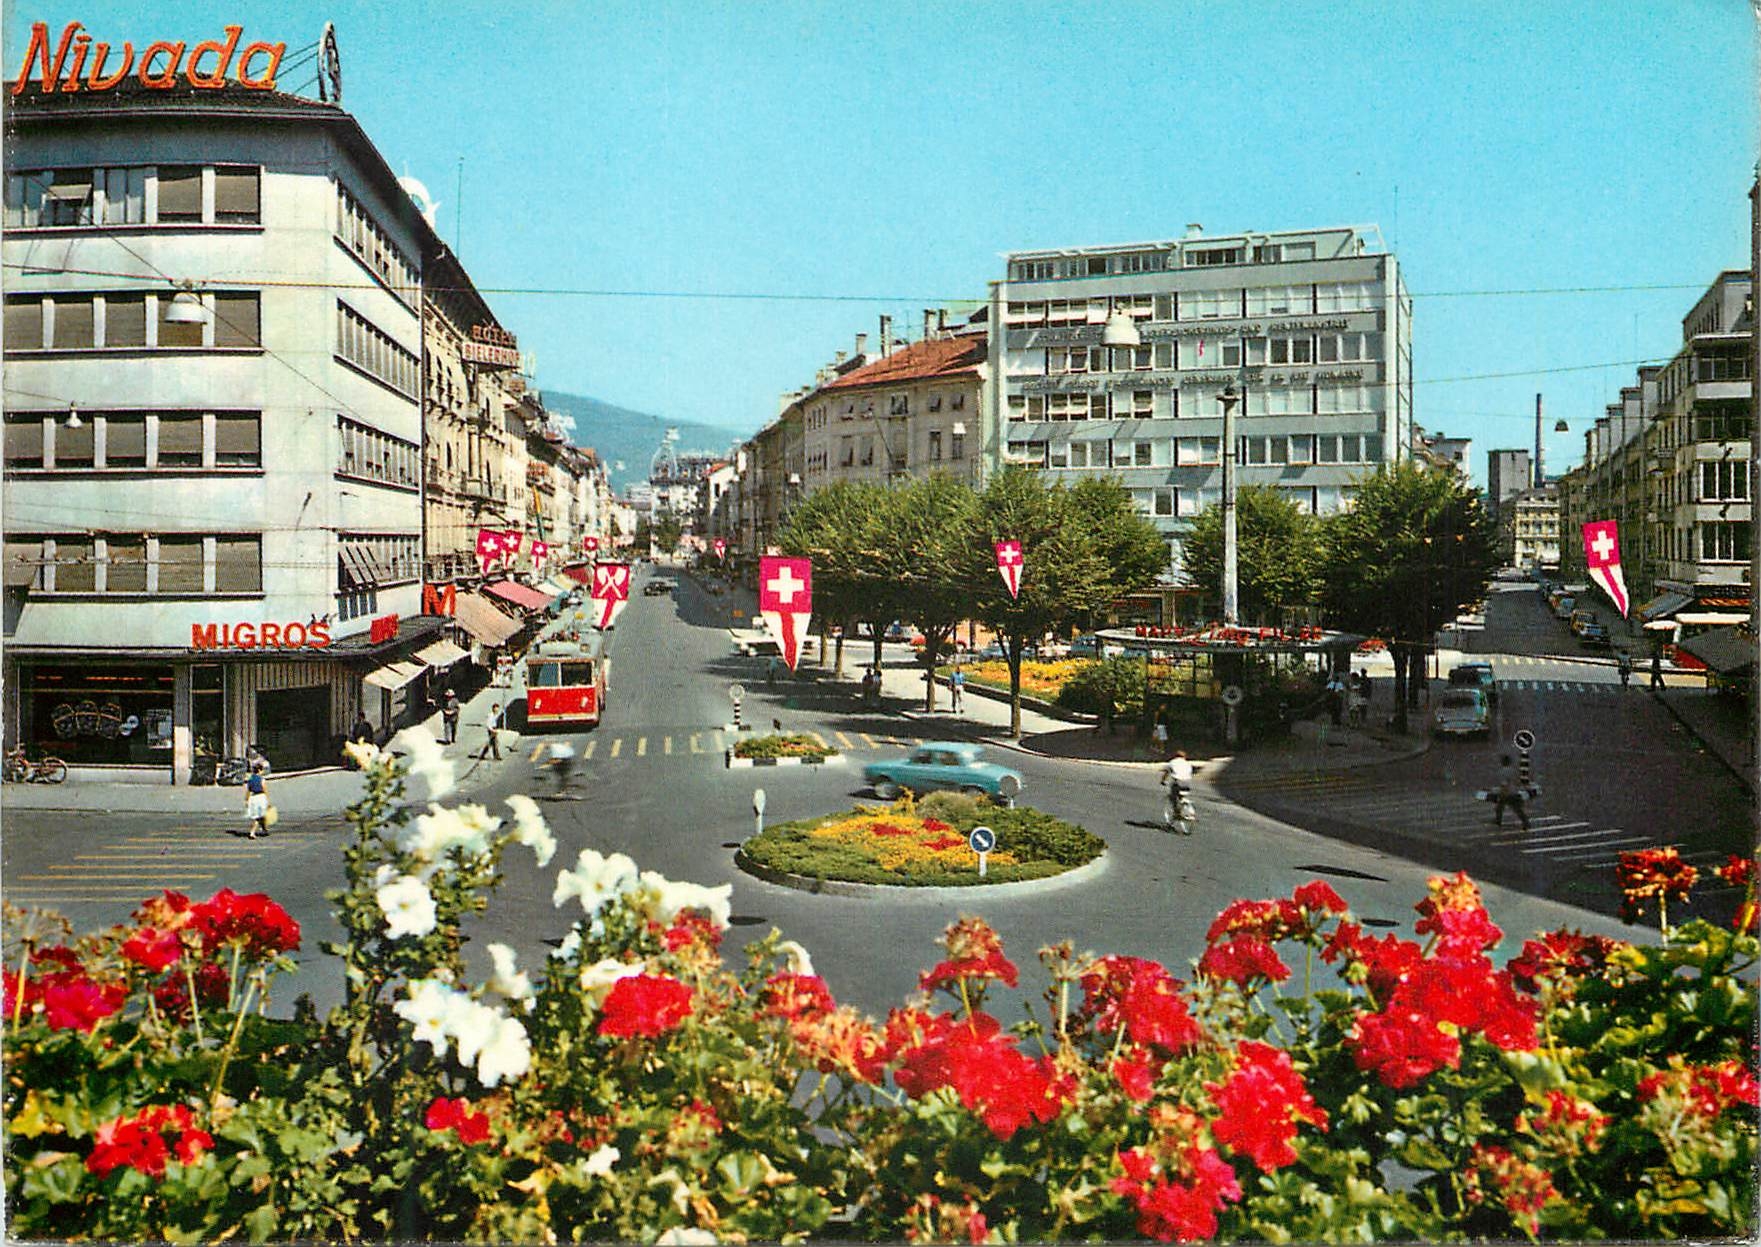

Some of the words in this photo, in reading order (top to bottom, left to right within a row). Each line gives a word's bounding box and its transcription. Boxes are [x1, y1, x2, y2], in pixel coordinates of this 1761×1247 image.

[11, 20, 288, 96] Nivada
[422, 583, 456, 617] M
[191, 621, 331, 650] MIGROS
